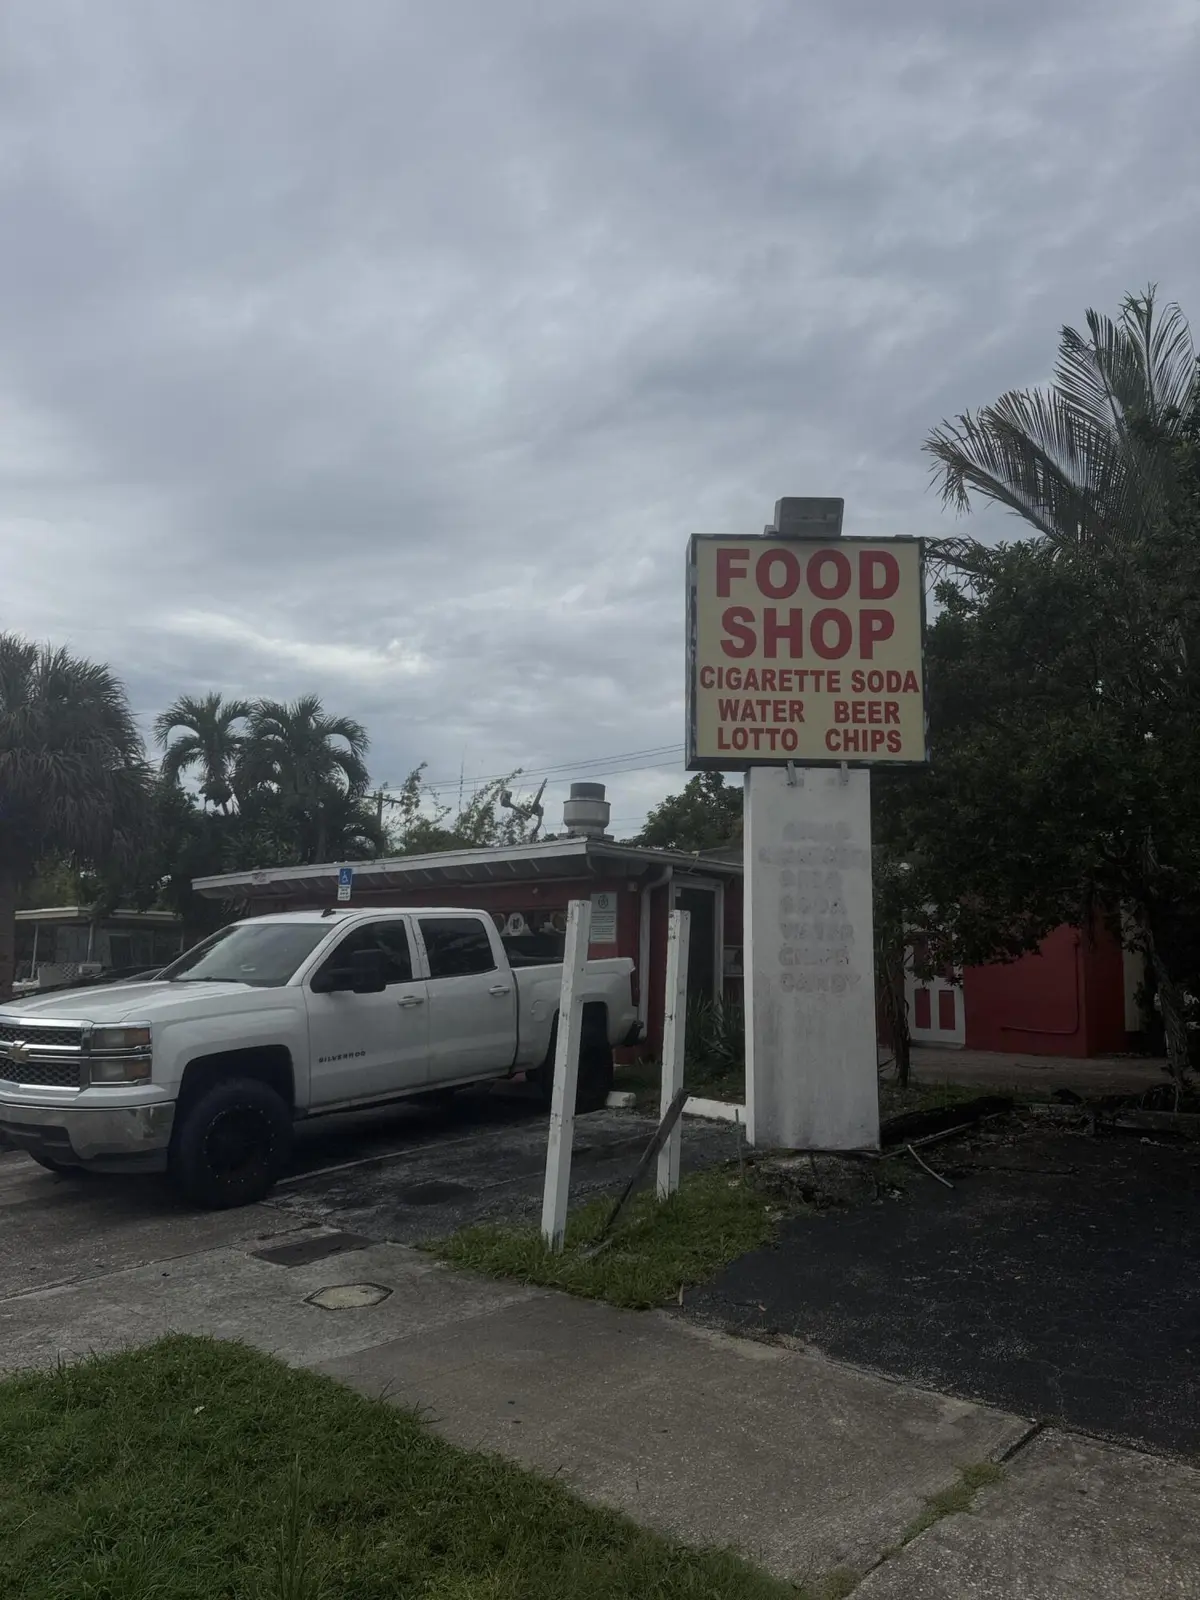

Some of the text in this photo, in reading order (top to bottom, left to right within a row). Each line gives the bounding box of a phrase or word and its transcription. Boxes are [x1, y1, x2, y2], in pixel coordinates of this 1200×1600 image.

[716, 548, 900, 600] FOOD
[720, 605, 895, 660] SHOP
[700, 666, 920, 693] CIGARETTE SODA
[718, 698, 901, 724] WATER BEER
[717, 727, 902, 753] LOTTO CHIPS
